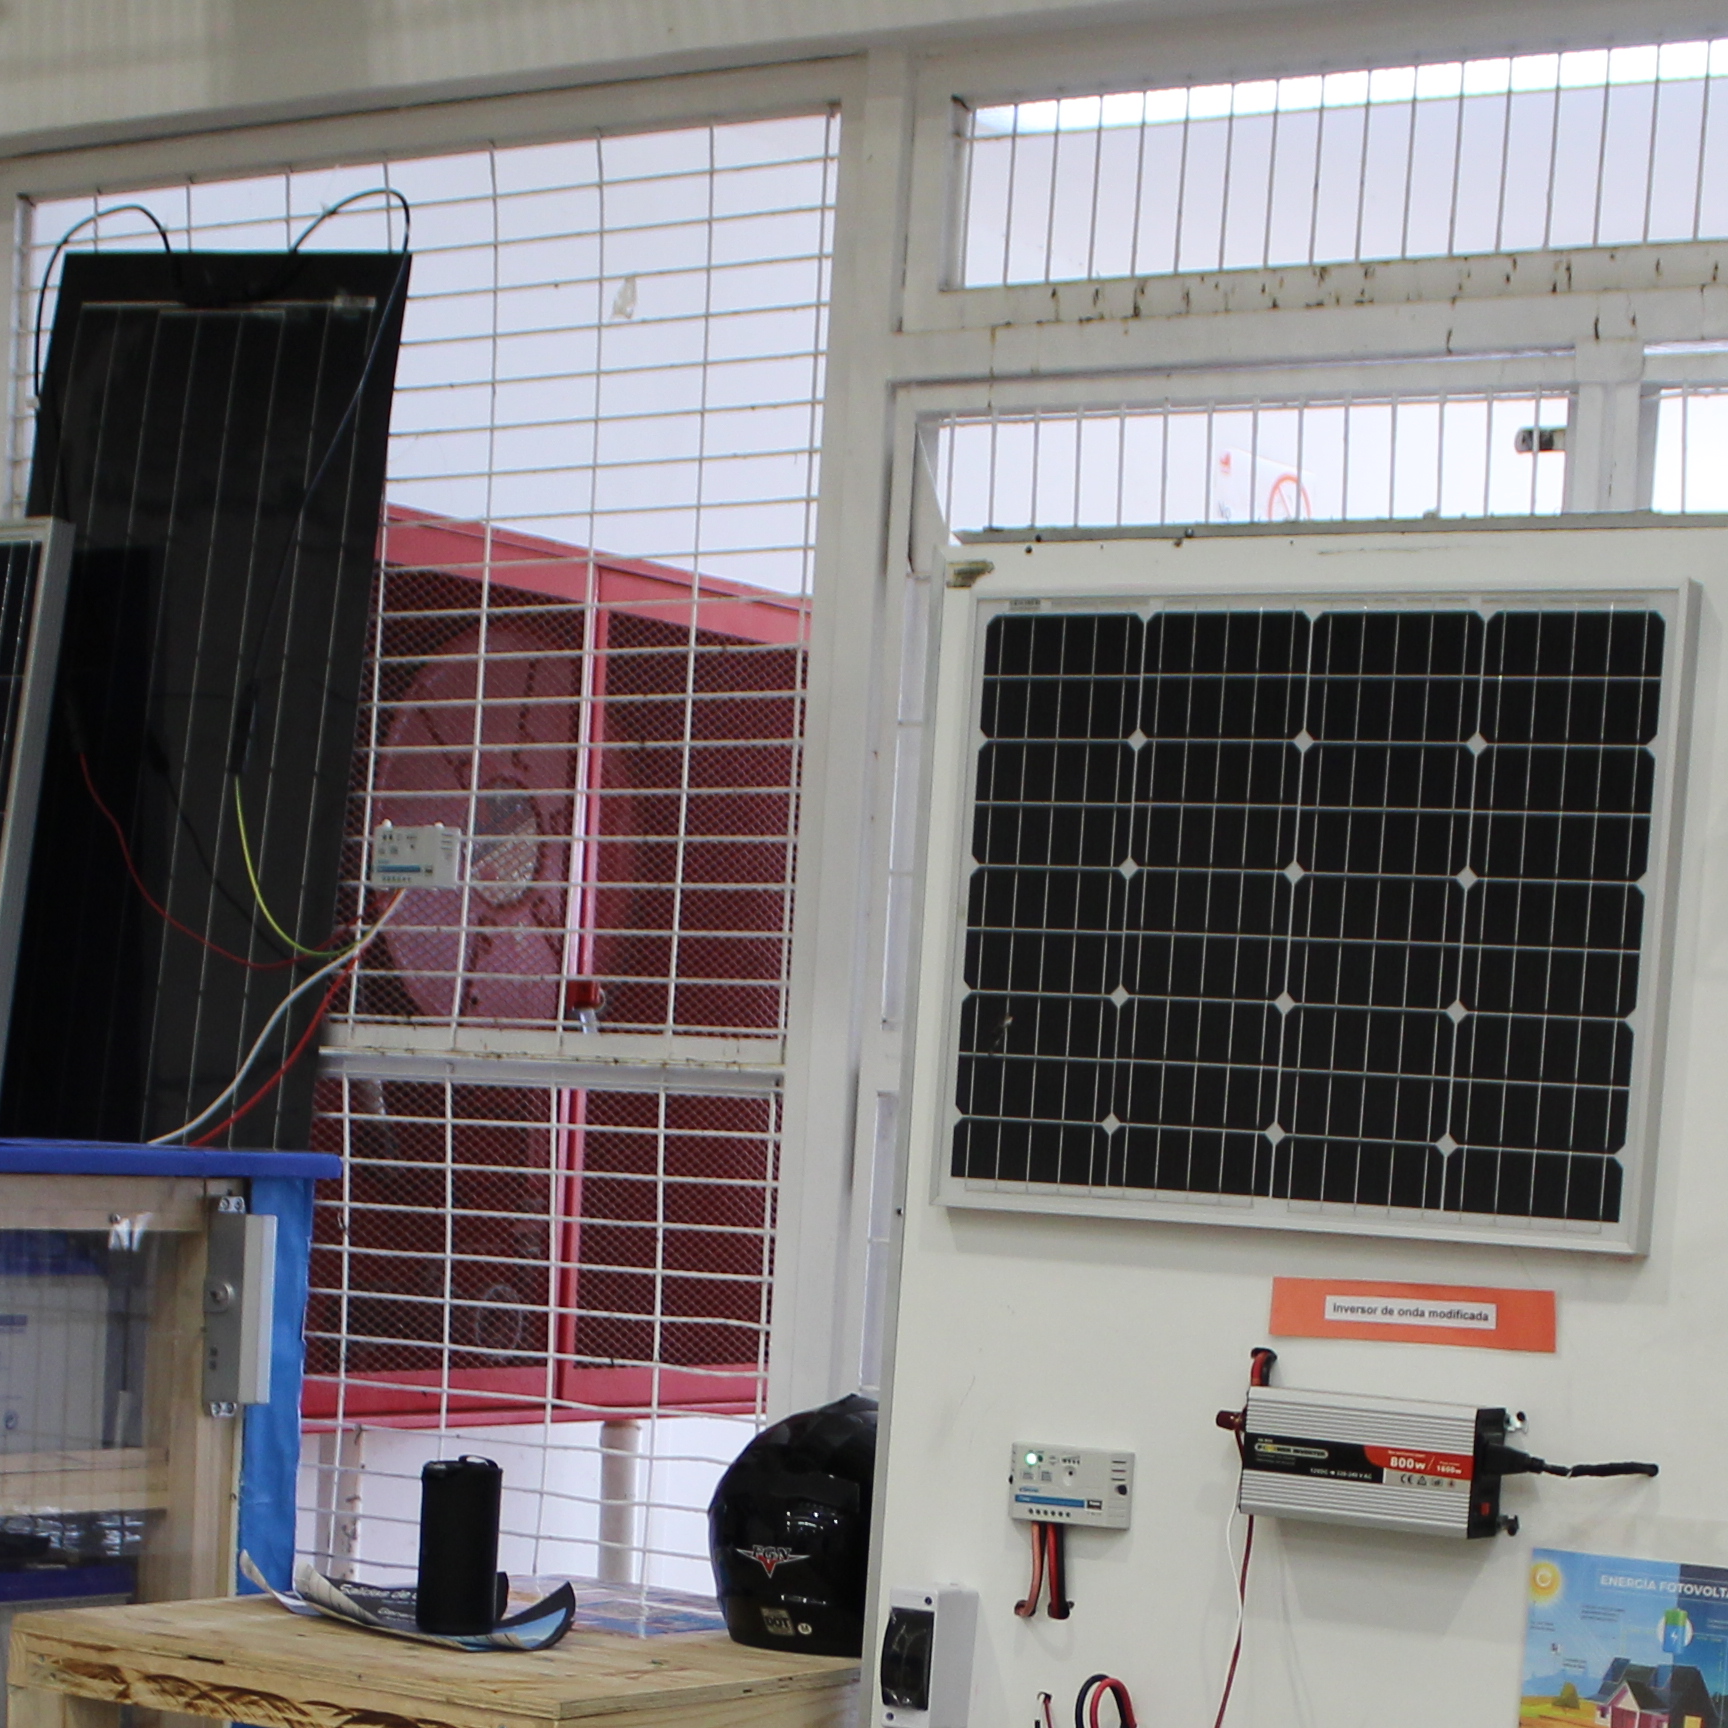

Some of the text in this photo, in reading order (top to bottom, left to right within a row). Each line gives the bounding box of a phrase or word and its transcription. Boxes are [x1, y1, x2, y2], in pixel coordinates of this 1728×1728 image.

[1332, 1302, 1490, 1322] Inversor de onda modificada
[1600, 1573, 1656, 1592] ENERGÍA
